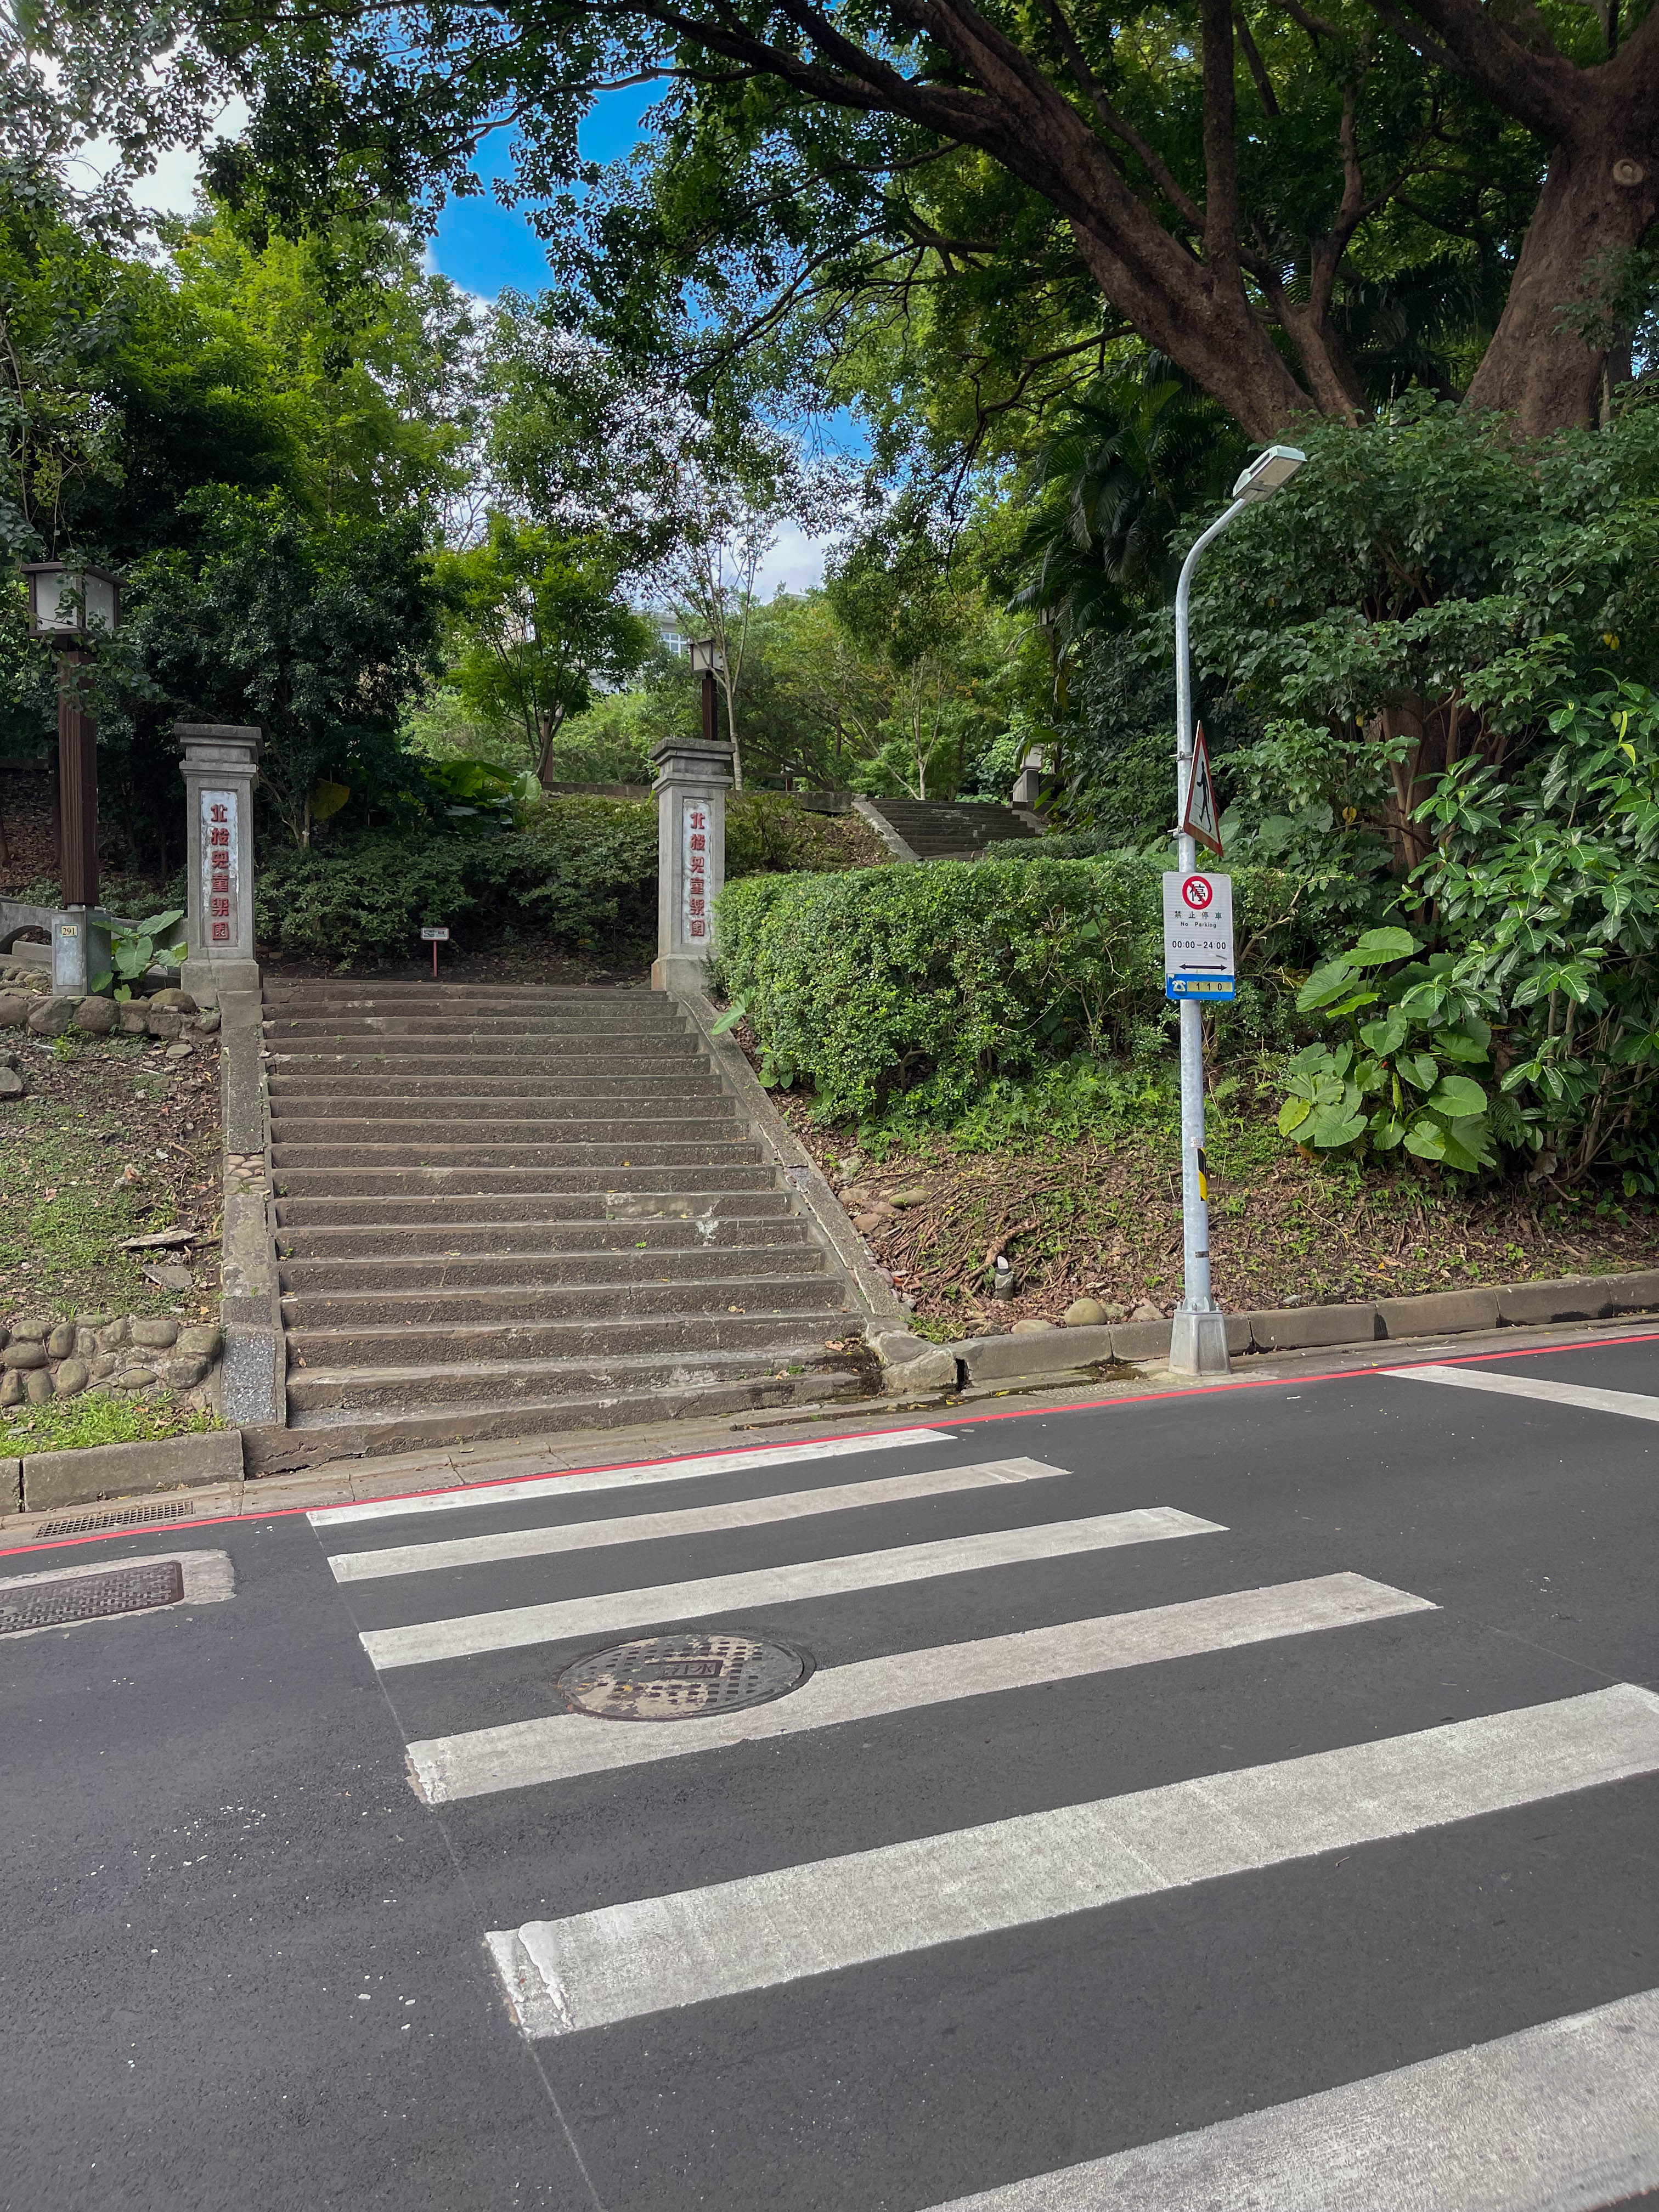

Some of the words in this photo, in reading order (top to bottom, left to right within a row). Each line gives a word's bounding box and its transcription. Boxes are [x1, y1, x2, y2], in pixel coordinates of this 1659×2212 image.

[211, 804, 229, 940] 北投兒童樂園
[690, 811, 706, 937] 北投兒童樂園
[1190, 884, 1206, 901] 停
[1175, 910, 1222, 920] 禁止停車
[63, 927, 75, 935] 291
